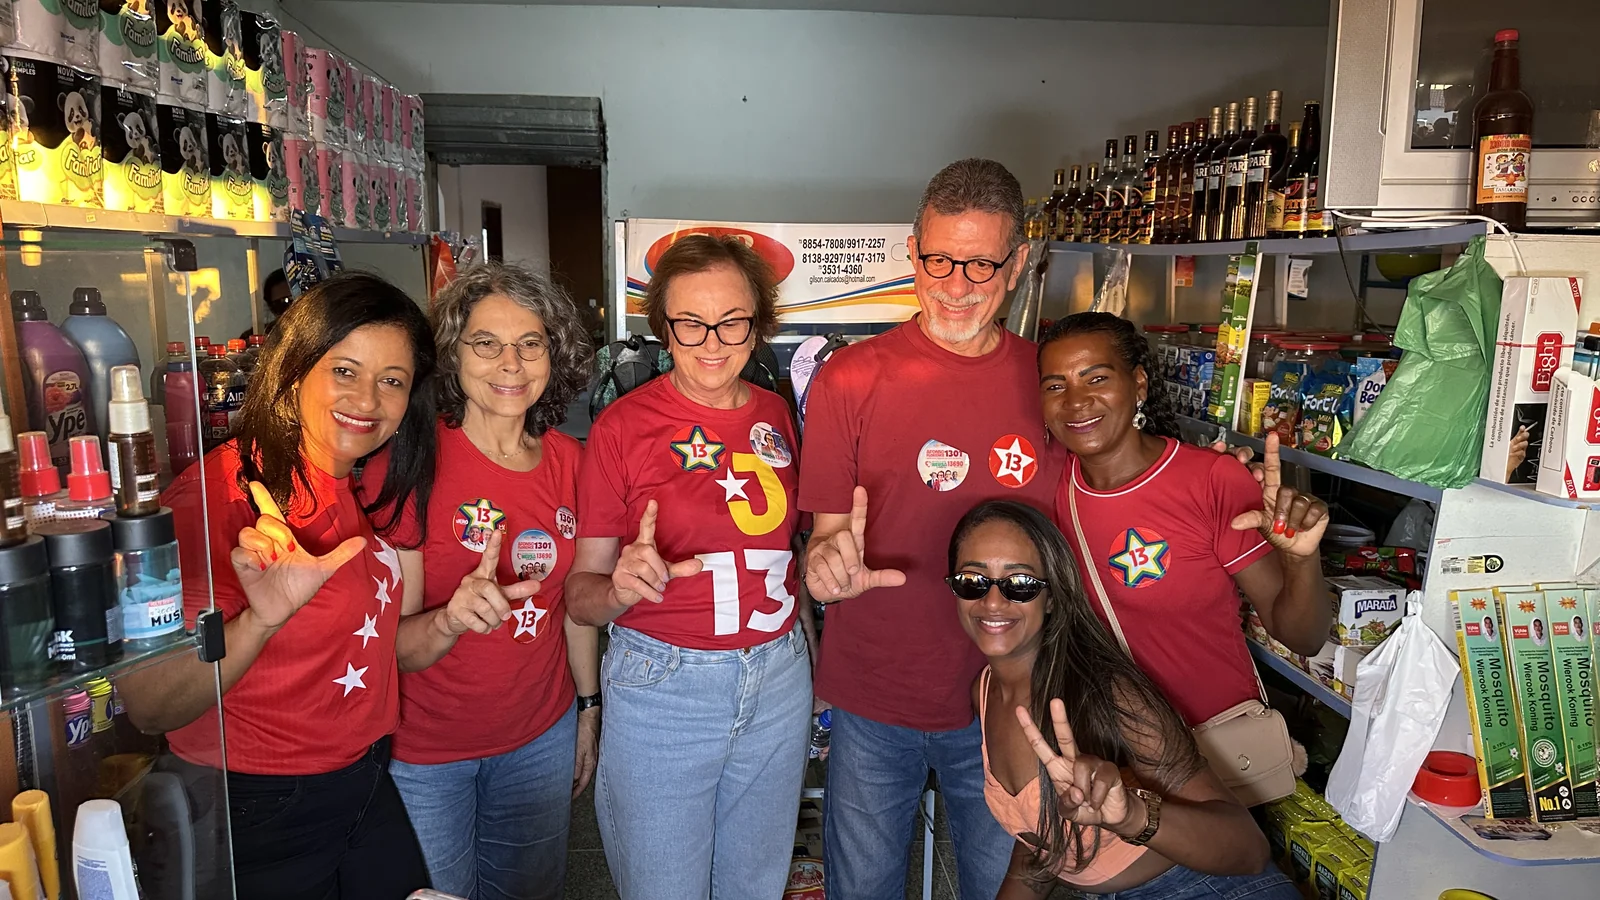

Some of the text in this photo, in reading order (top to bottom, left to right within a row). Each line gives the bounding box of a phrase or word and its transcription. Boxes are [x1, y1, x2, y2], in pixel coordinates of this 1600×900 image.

[170, 36, 204, 64] Familiar
[802, 238, 886, 248] 8854-7808/9917-2257
[802, 253, 886, 263] 8138-9297/9147-3179
[822, 264, 862, 274] 3531-4360
[1571, 282, 1579, 298] BOX
[1536, 338, 1557, 386] Eight
[1552, 417, 1556, 425] de
[690, 444, 708, 458] 13
[1005, 452, 1022, 472] 13
[1566, 480, 1576, 495] BOX
[476, 508, 490, 522] 13
[559, 513, 574, 525] 1301
[1129, 546, 1149, 567] 13
[694, 549, 795, 636] 13
[521, 610, 537, 628] 13
[1476, 658, 1488, 694] Wierook
[1482, 696, 1492, 728] Koning
[1489, 658, 1509, 726] Mosquito
[1523, 662, 1535, 697] Wierook
[1529, 700, 1538, 731] Koning
[1537, 661, 1555, 730] Mosquito
[1563, 658, 1578, 727] Wierook Koning
[1577, 658, 1596, 726] Mosquito
[1539, 796, 1560, 811] No.1
